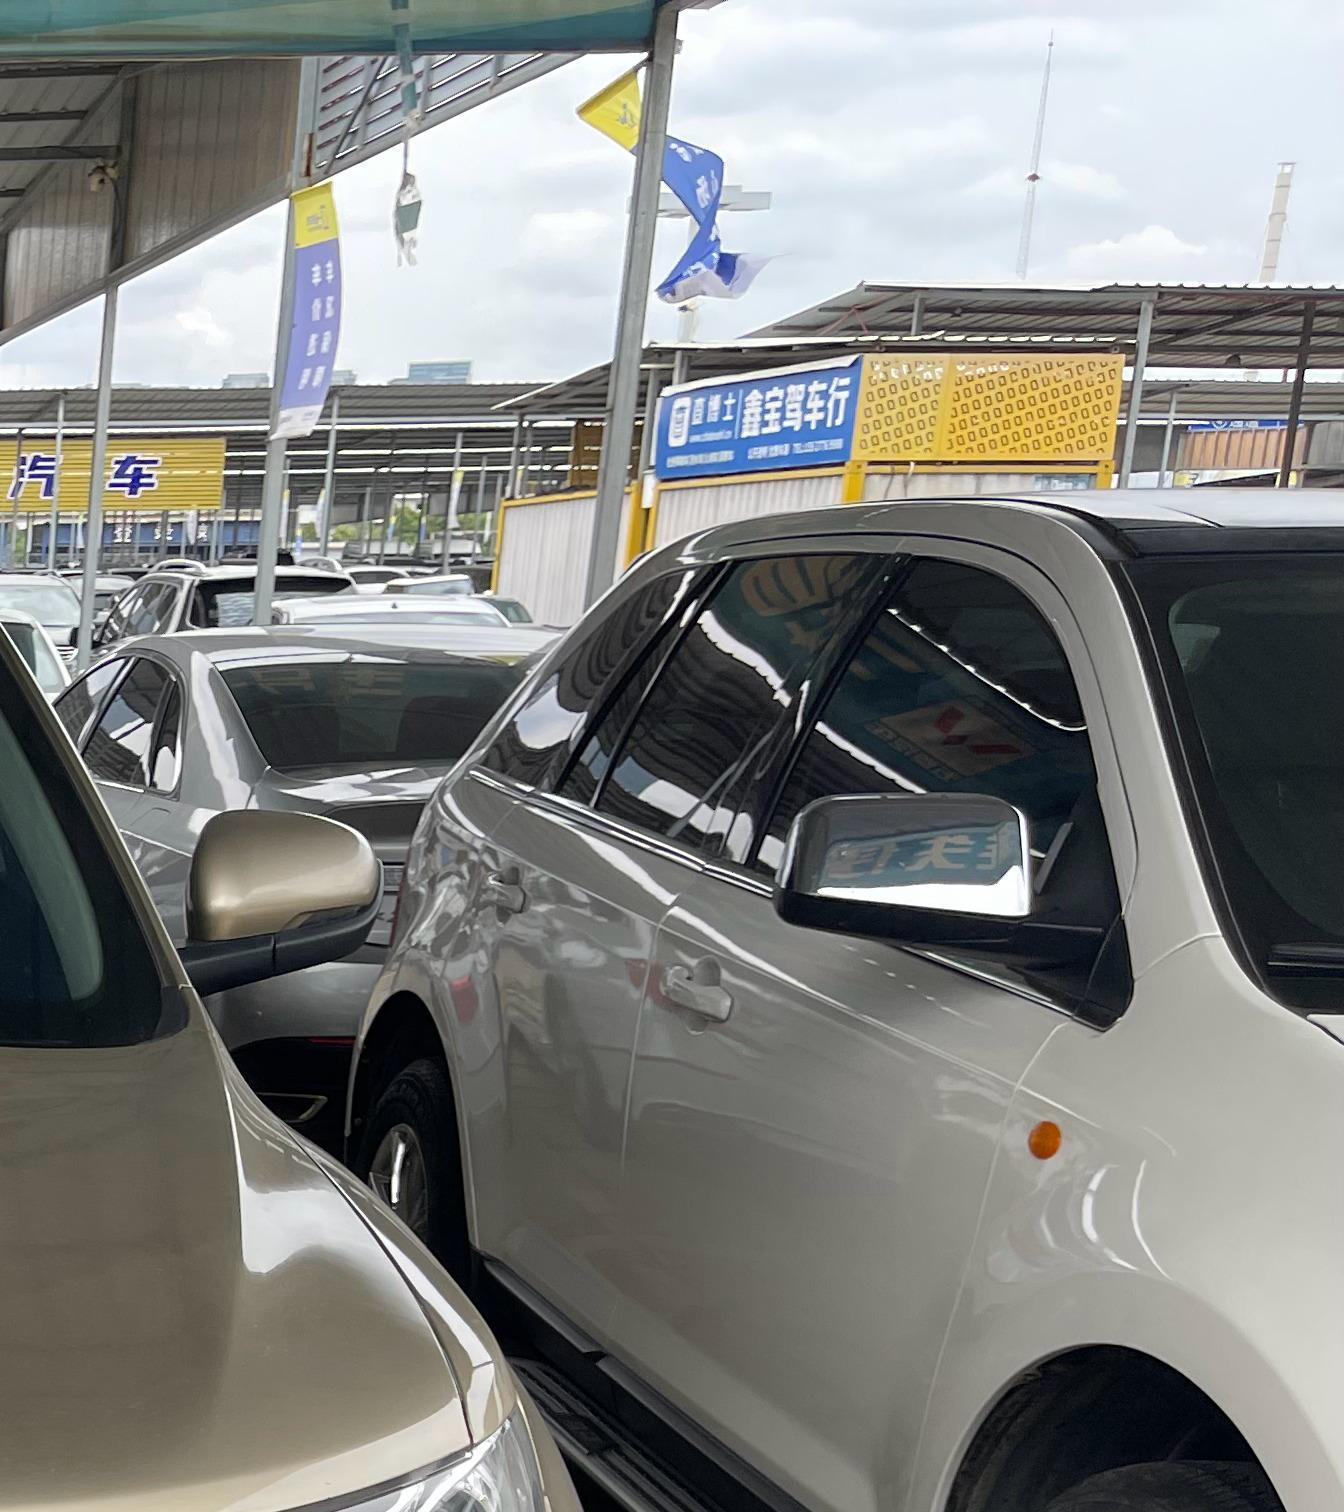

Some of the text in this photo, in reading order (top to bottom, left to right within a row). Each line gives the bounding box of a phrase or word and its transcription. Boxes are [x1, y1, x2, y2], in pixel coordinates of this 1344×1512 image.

[740, 376, 851, 439] 鑫宝驾车行
